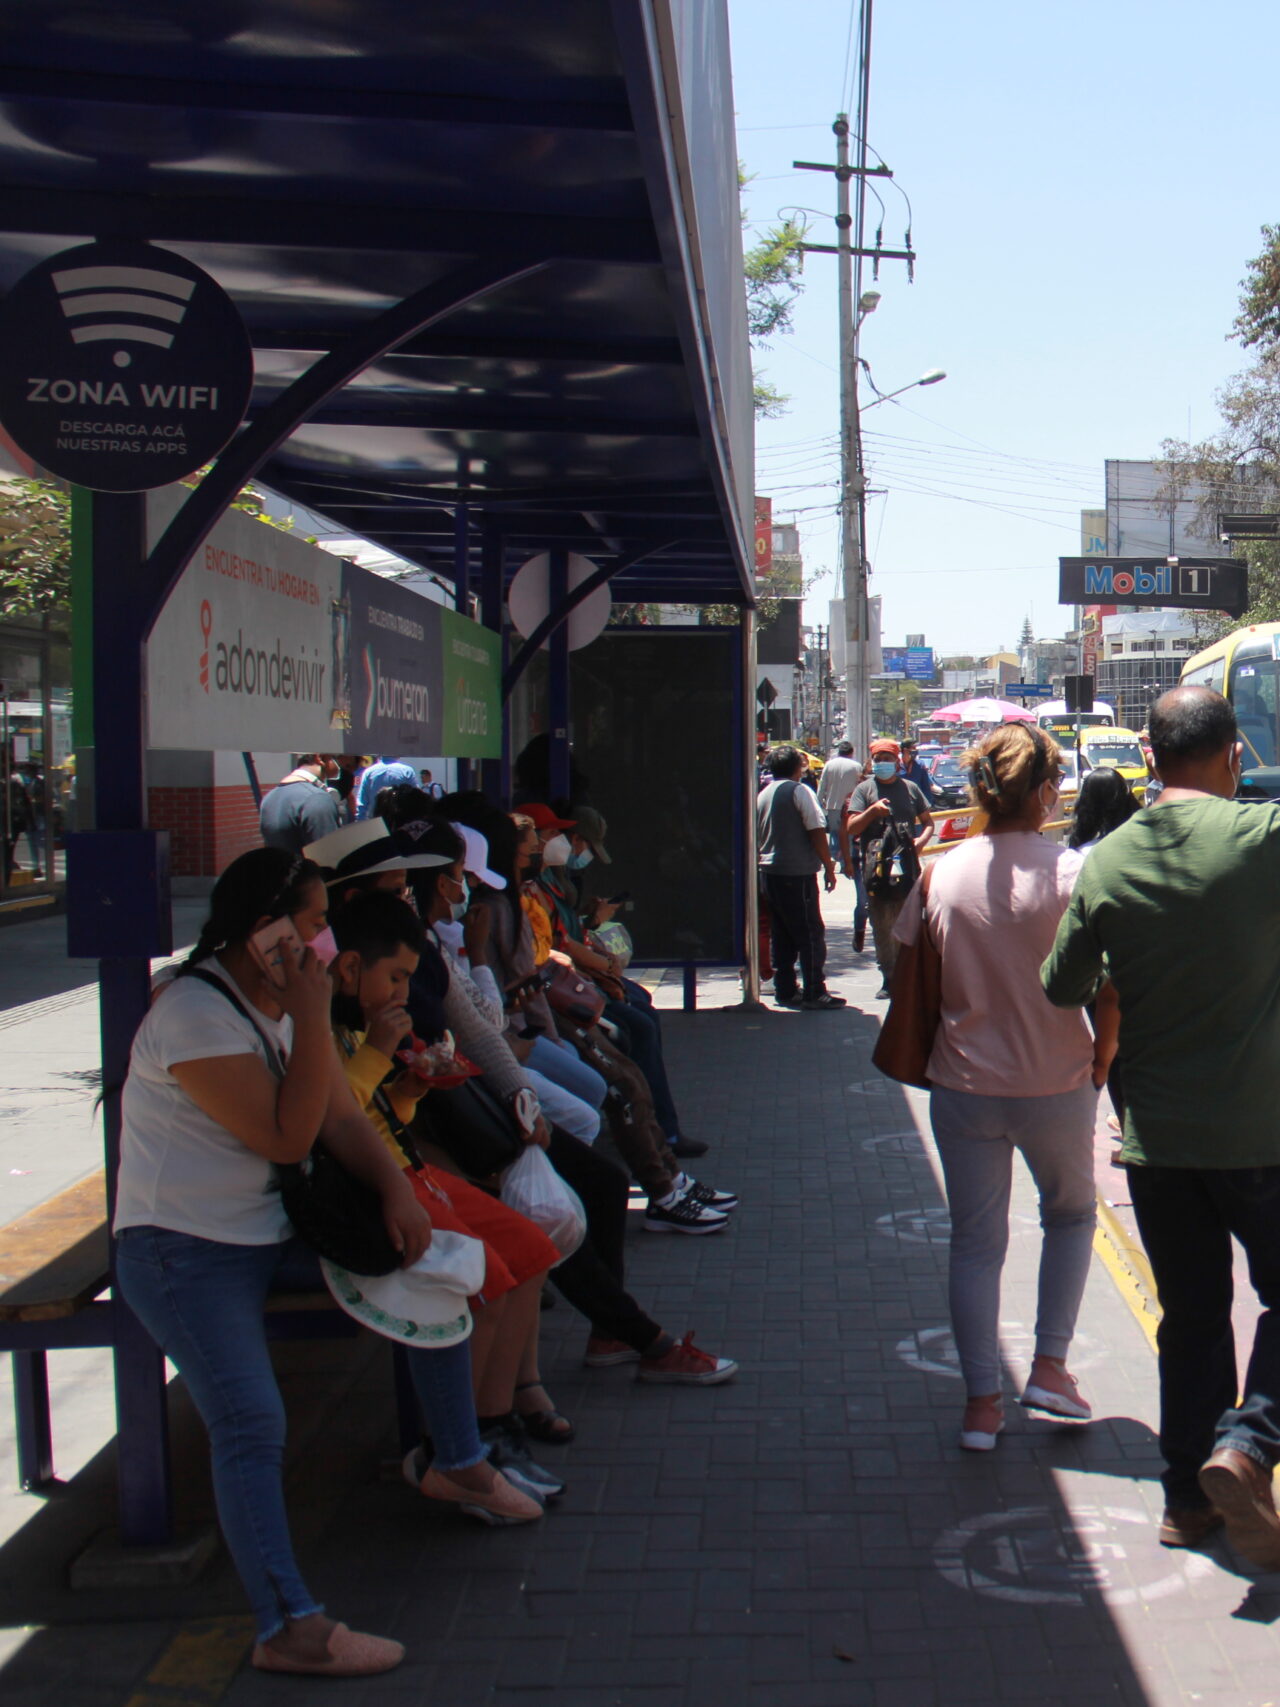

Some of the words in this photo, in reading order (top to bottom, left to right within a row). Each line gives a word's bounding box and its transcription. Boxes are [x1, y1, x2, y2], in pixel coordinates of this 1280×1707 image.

[27, 378, 130, 406] ZONA
[141, 384, 218, 410] WIFI
[60, 421, 148, 436] DESCARGA
[152, 423, 185, 438] ACÁ
[56, 438, 141, 453] NUESTRAS
[145, 442, 188, 455] APPS
[205, 545, 262, 586] ENCUENTRA
[265, 567, 276, 591] TU
[278, 570, 308, 599] HOGAR
[309, 583, 320, 606] EN
[1085, 566, 1172, 594] Mobil
[215, 628, 325, 704] adondevivir
[377, 658, 429, 723] bumeran
